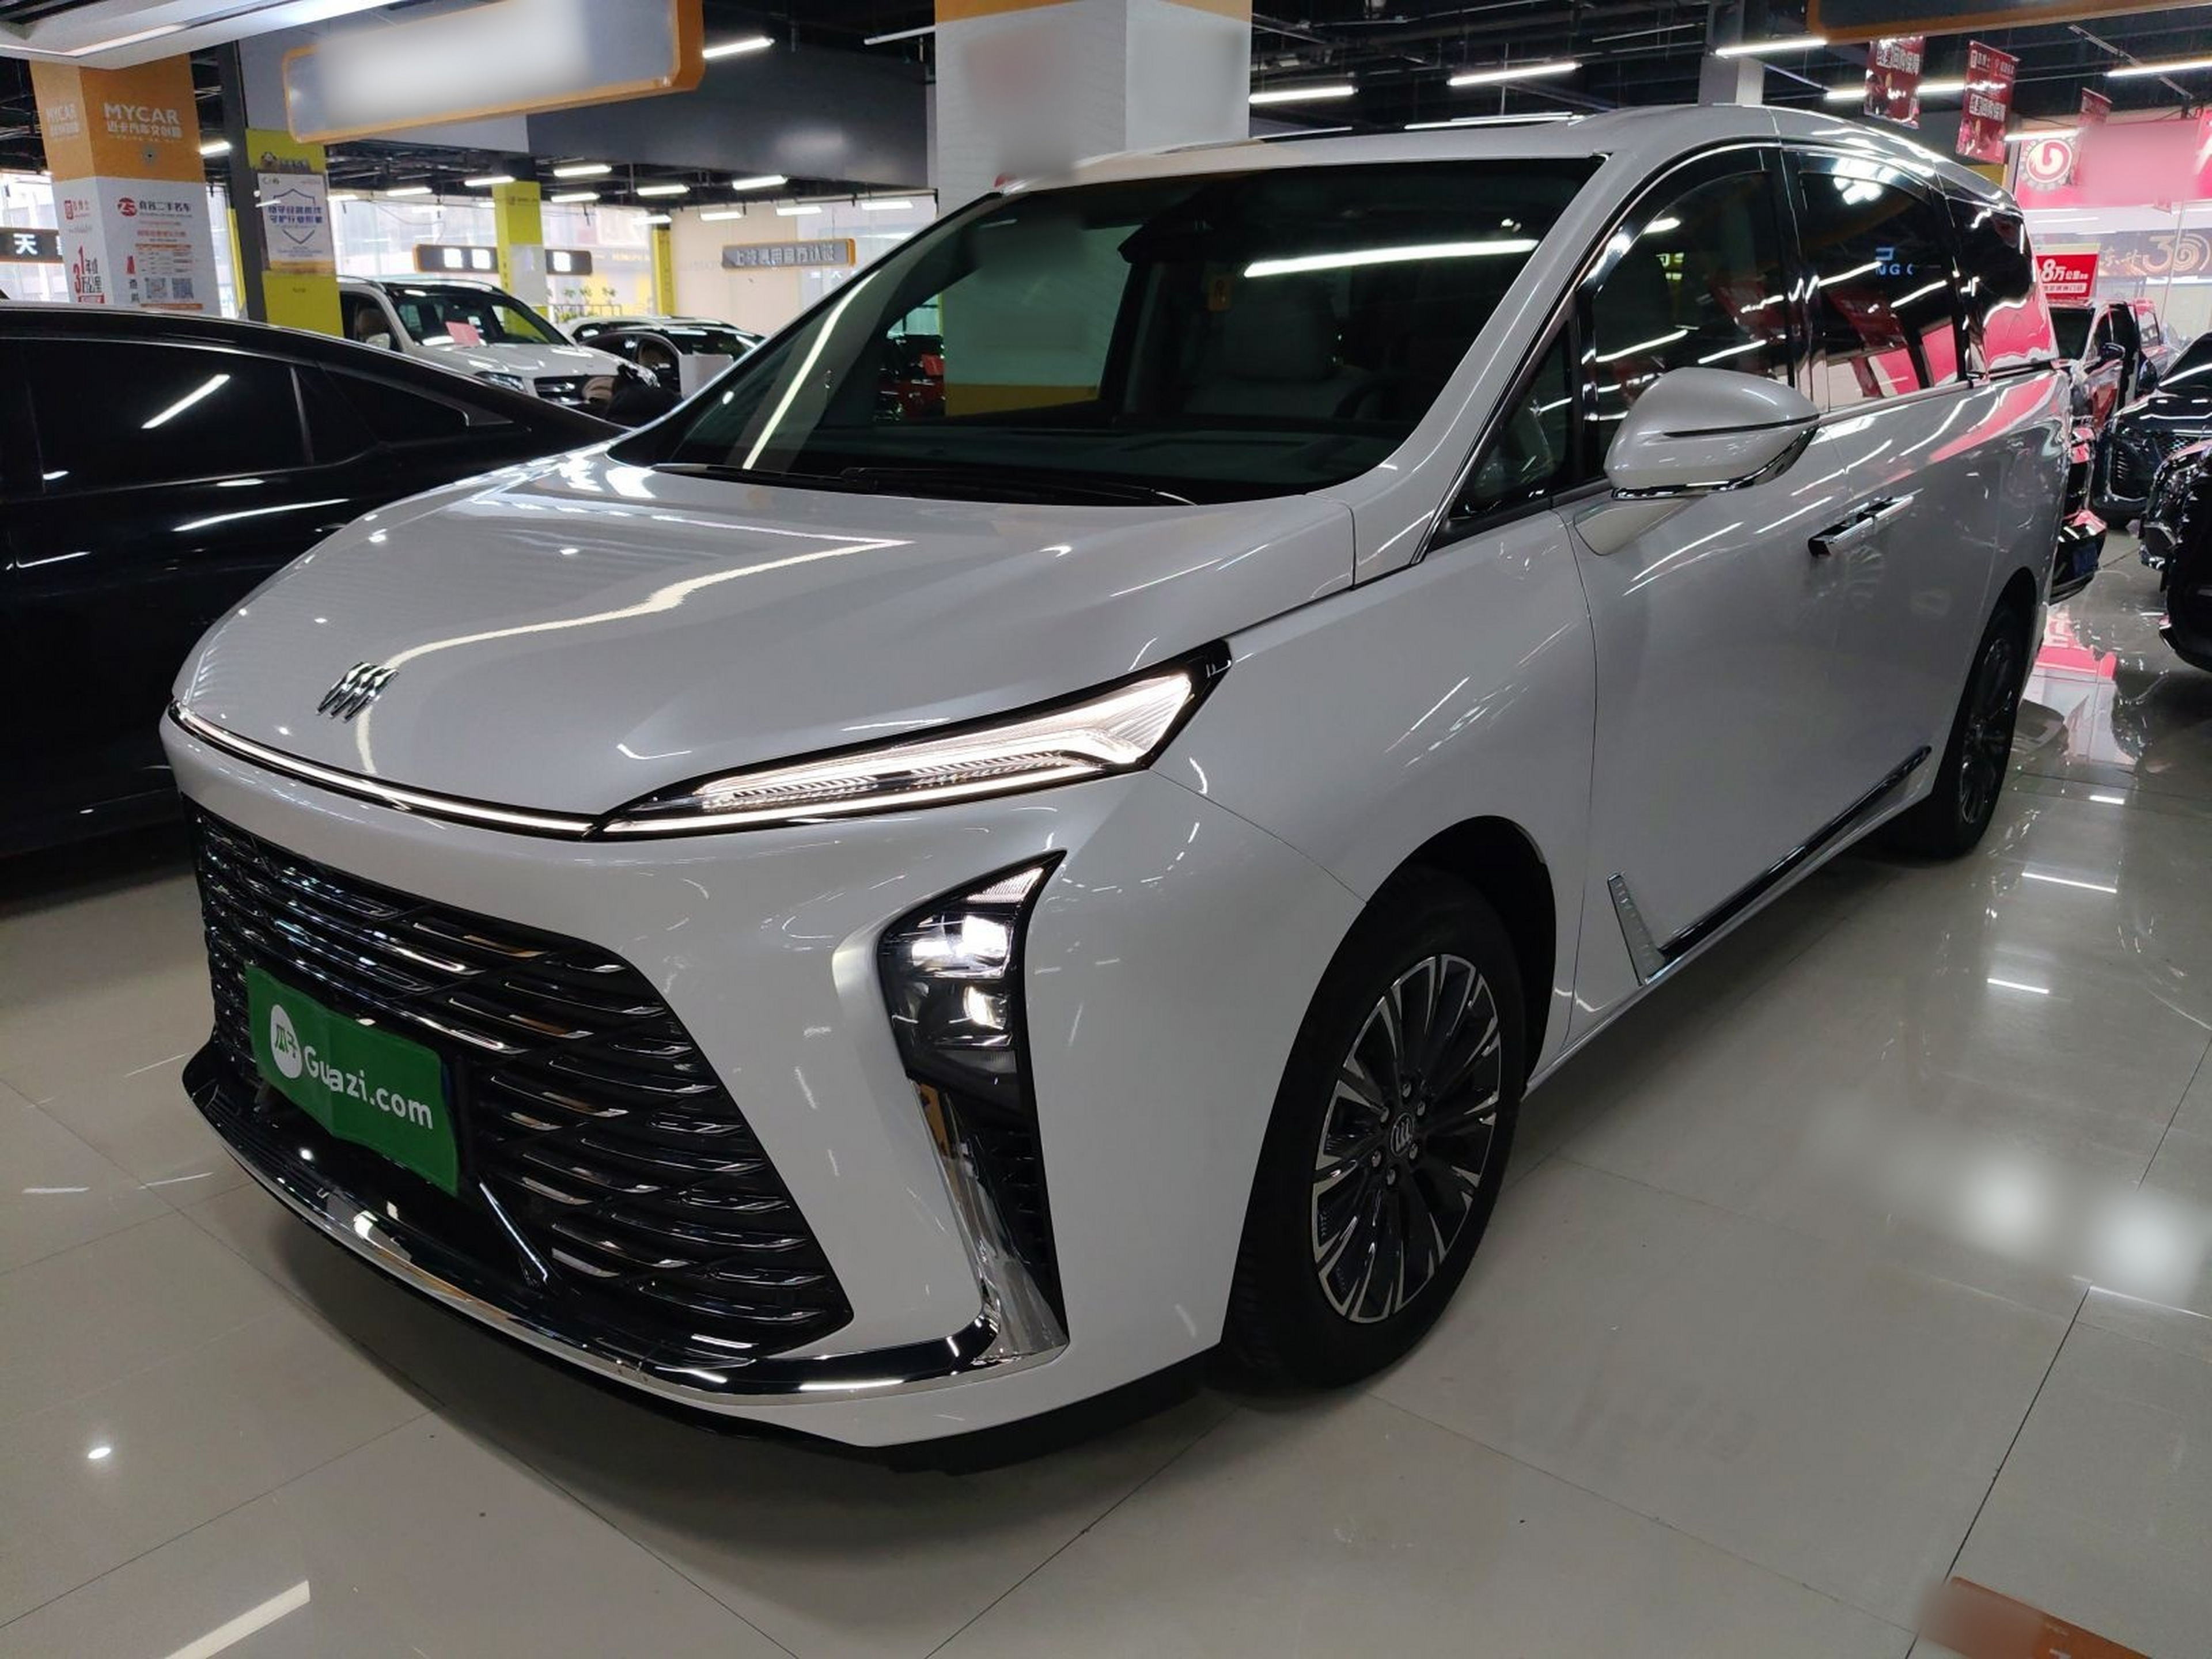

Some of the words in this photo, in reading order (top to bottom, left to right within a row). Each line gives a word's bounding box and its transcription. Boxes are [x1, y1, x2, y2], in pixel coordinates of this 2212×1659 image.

[104, 103, 180, 125] MYCAR
[13, 233, 37, 255] 天
[304, 1046, 433, 1129] Guazi.com
